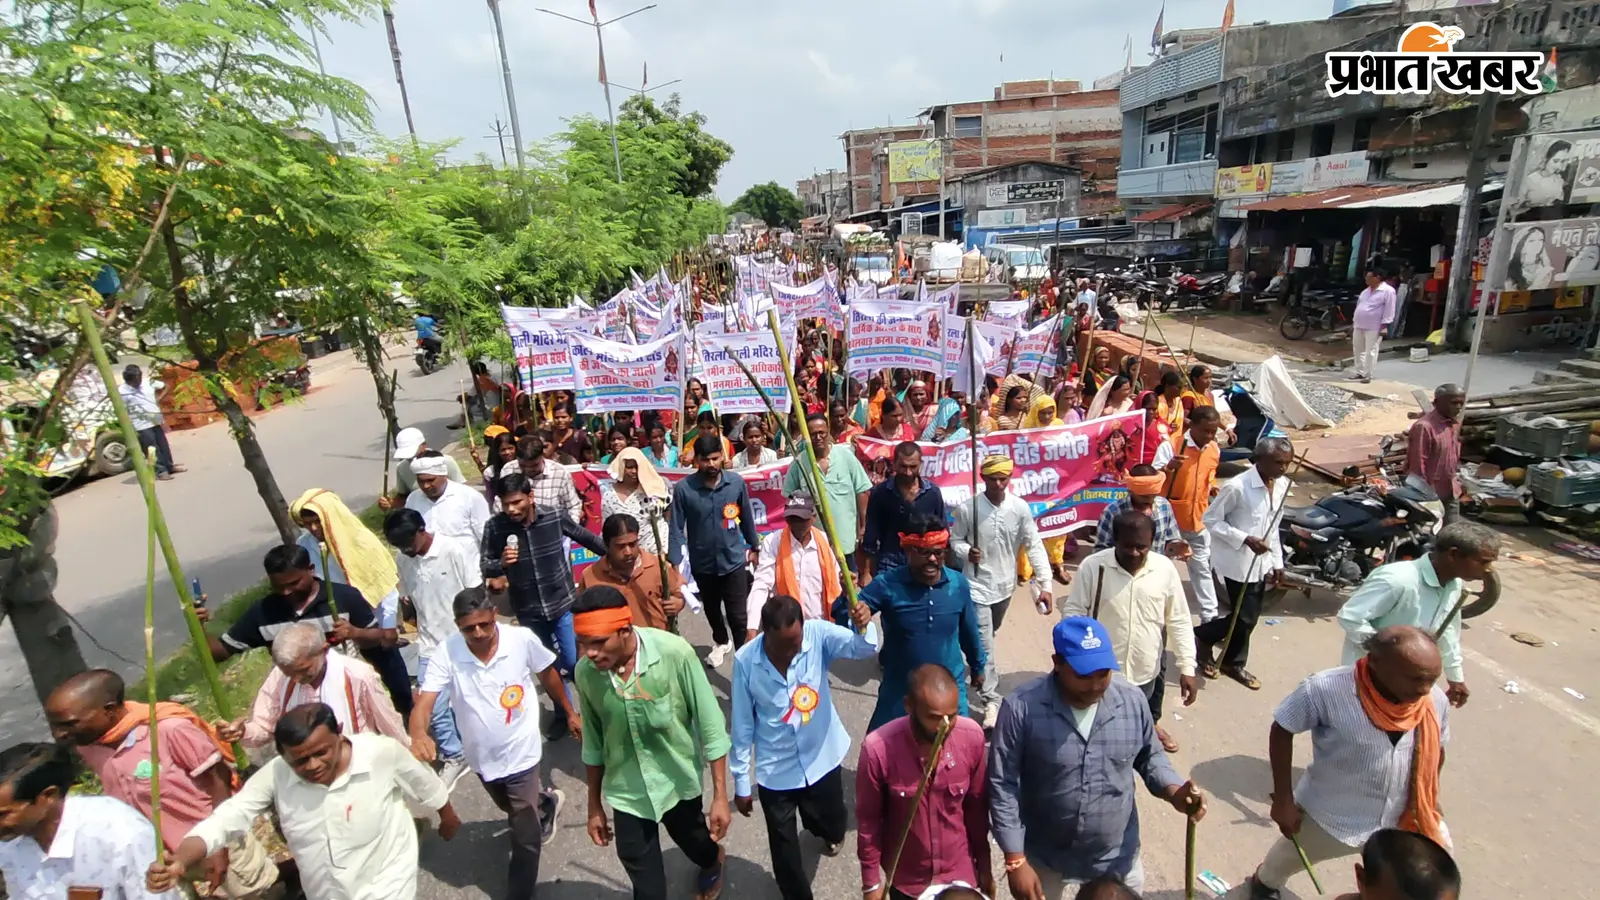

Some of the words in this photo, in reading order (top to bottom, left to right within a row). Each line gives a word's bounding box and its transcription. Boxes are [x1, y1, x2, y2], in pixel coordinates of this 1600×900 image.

[1327, 160, 1347, 170] Amul
[753, 344, 774, 358] मंदिर
[1041, 431, 1089, 461] जमीन
